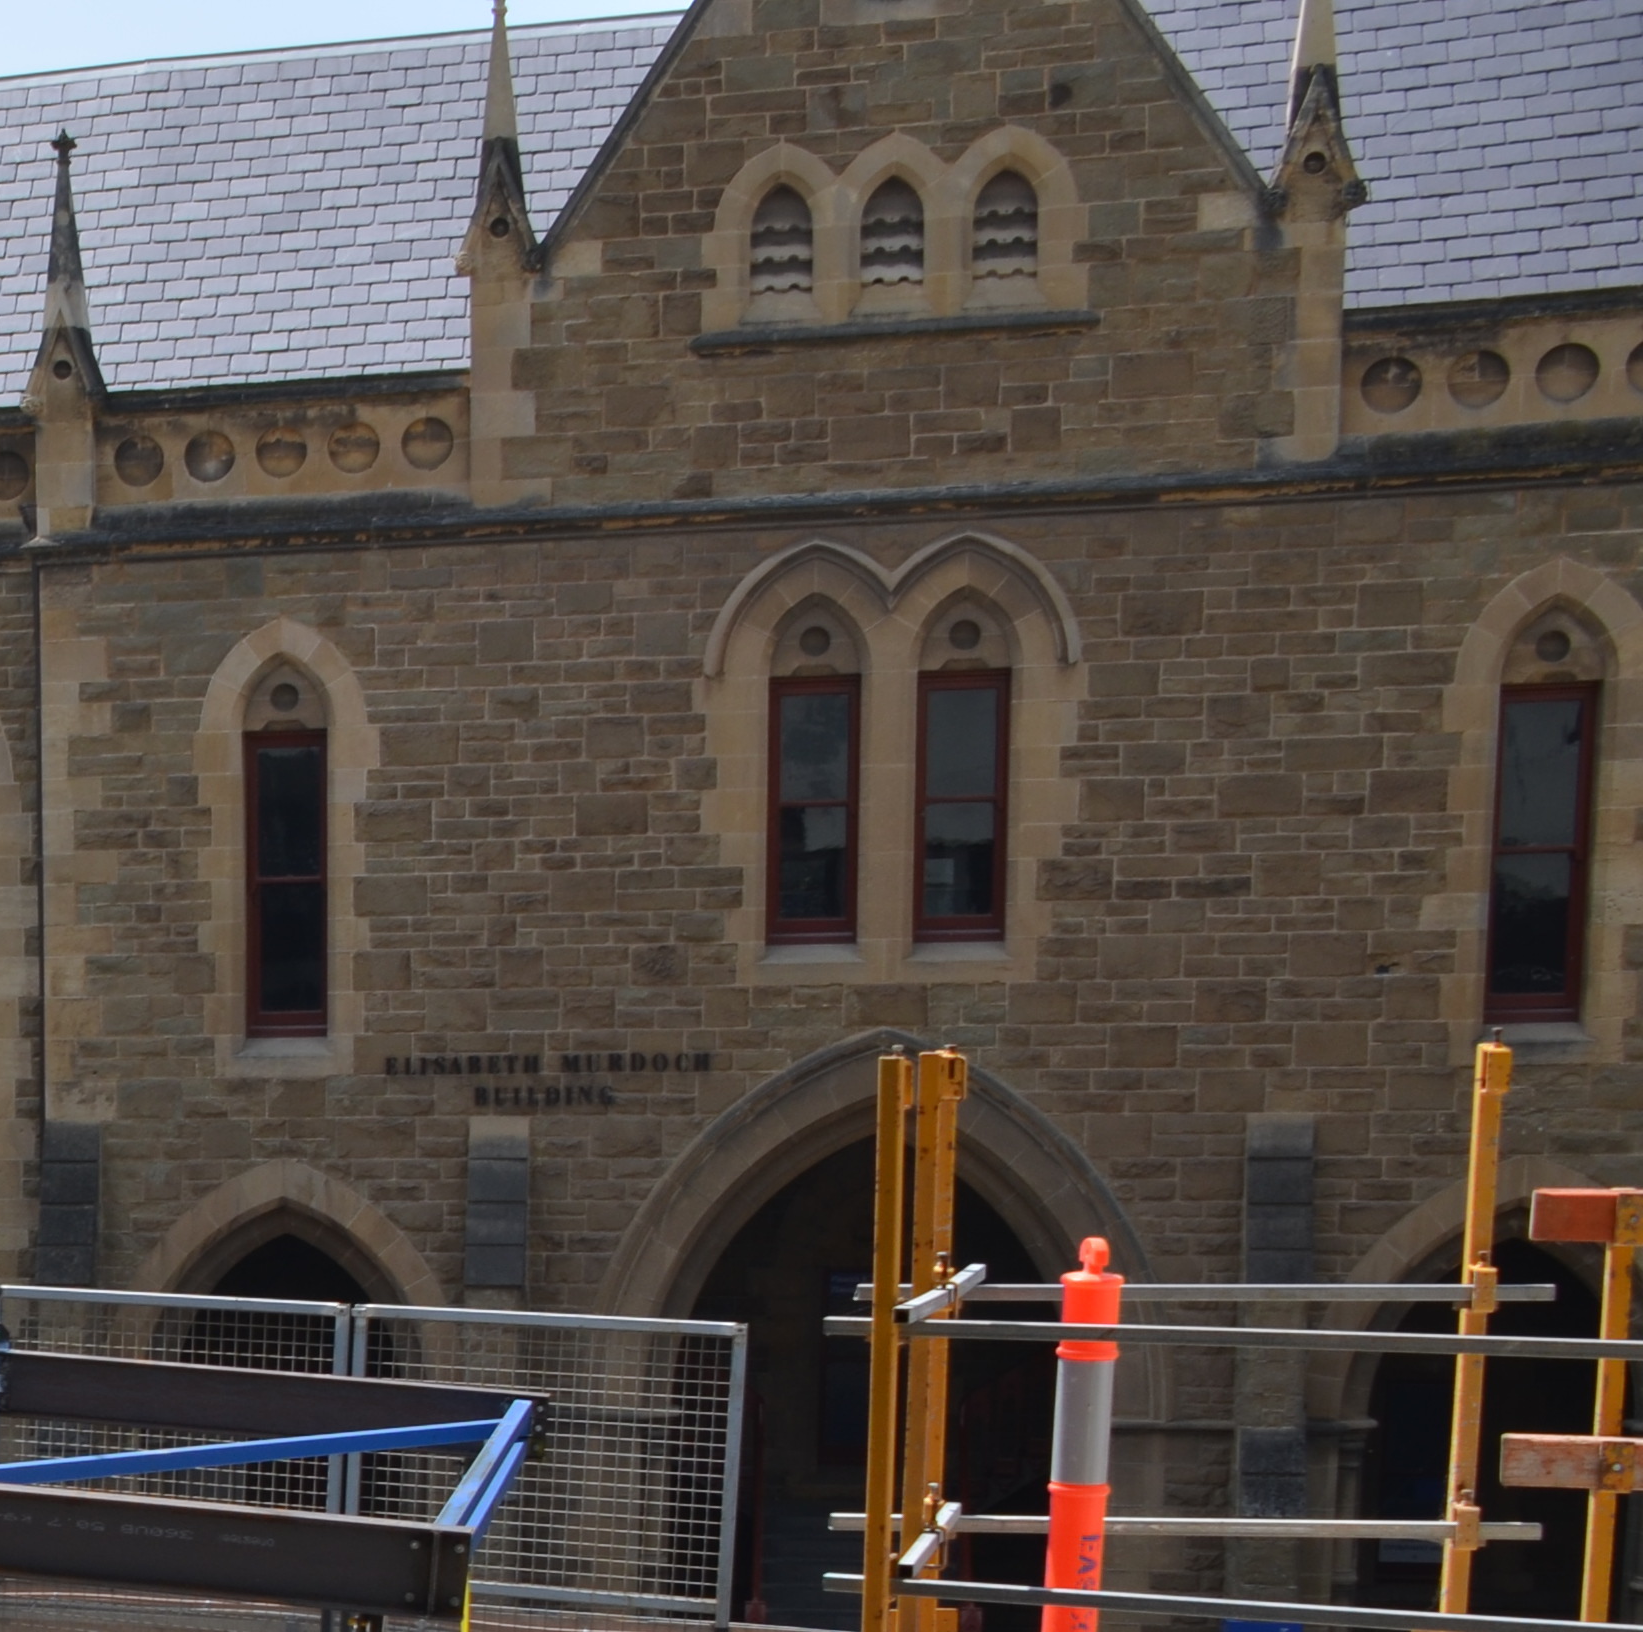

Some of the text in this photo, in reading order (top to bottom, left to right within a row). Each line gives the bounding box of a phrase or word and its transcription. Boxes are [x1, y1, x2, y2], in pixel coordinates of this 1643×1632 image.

[385, 1052, 712, 1077] ELISABETH MURDOCH
[474, 1084, 616, 1108] BUILDING
[46, 1516, 106, 1532] 50.7
[119, 1523, 195, 1541] 360UB
